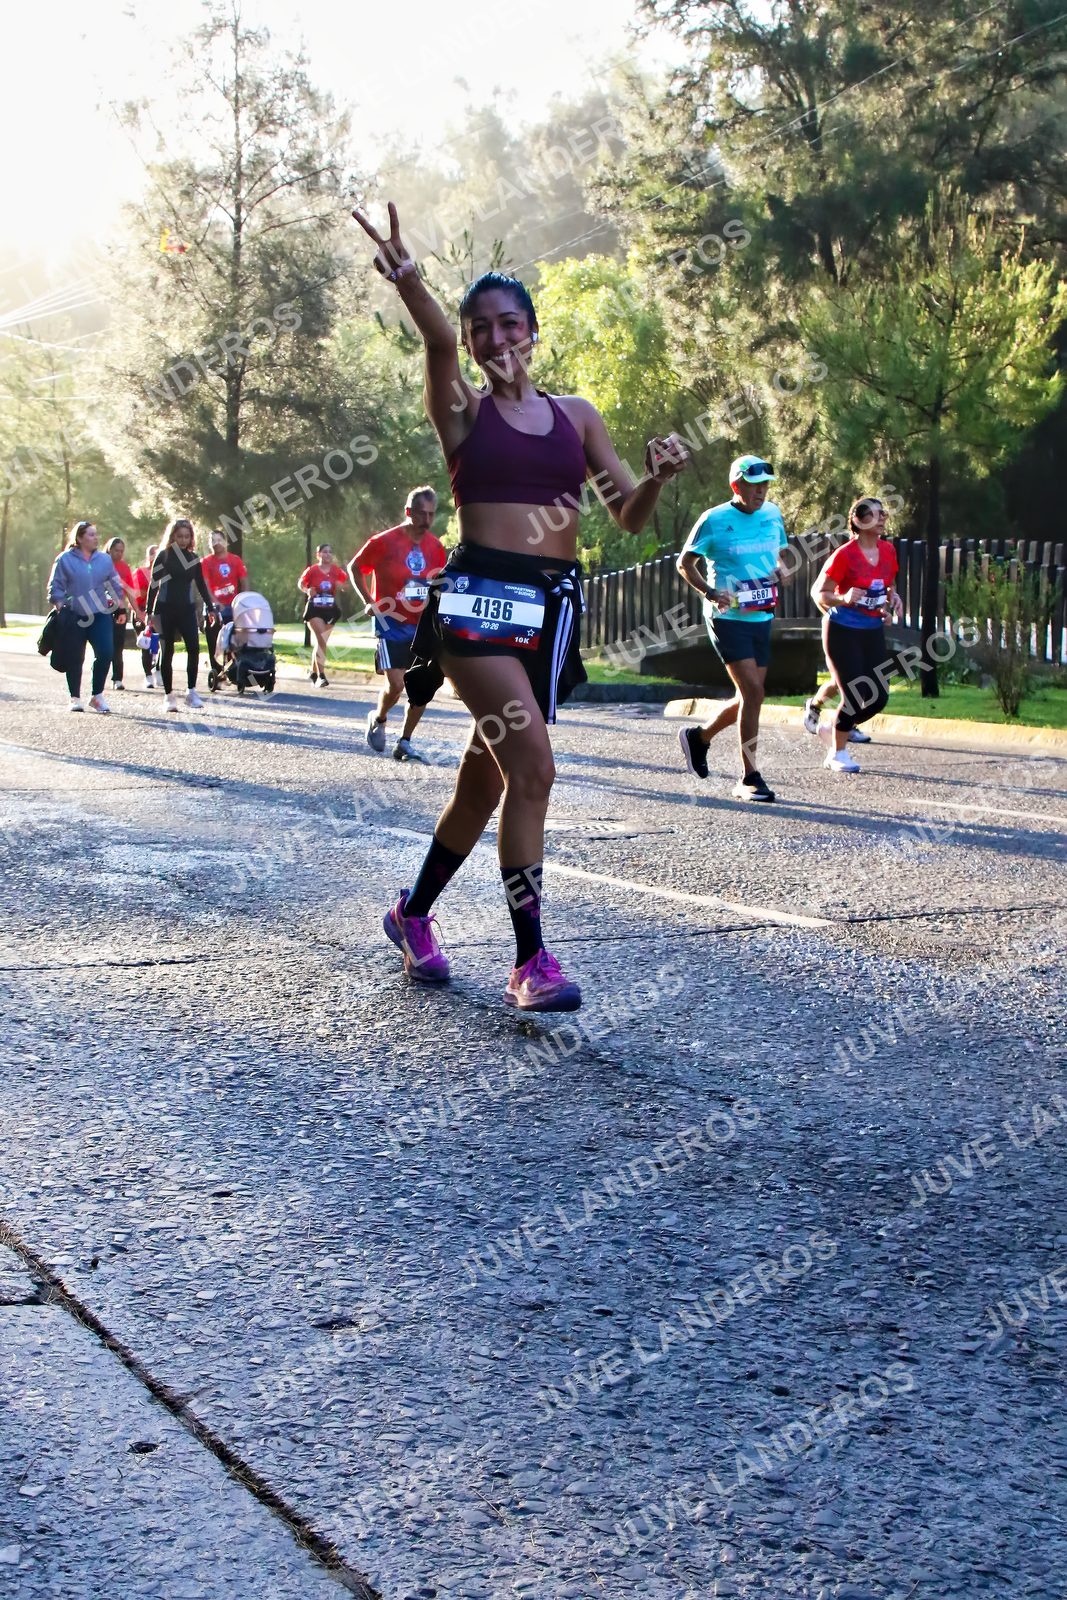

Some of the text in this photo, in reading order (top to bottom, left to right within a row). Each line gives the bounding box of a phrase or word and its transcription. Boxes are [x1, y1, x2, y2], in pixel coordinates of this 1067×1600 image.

[751, 589, 769, 600] 5687
[472, 597, 514, 622] 4136
[514, 635, 530, 644] 10K
